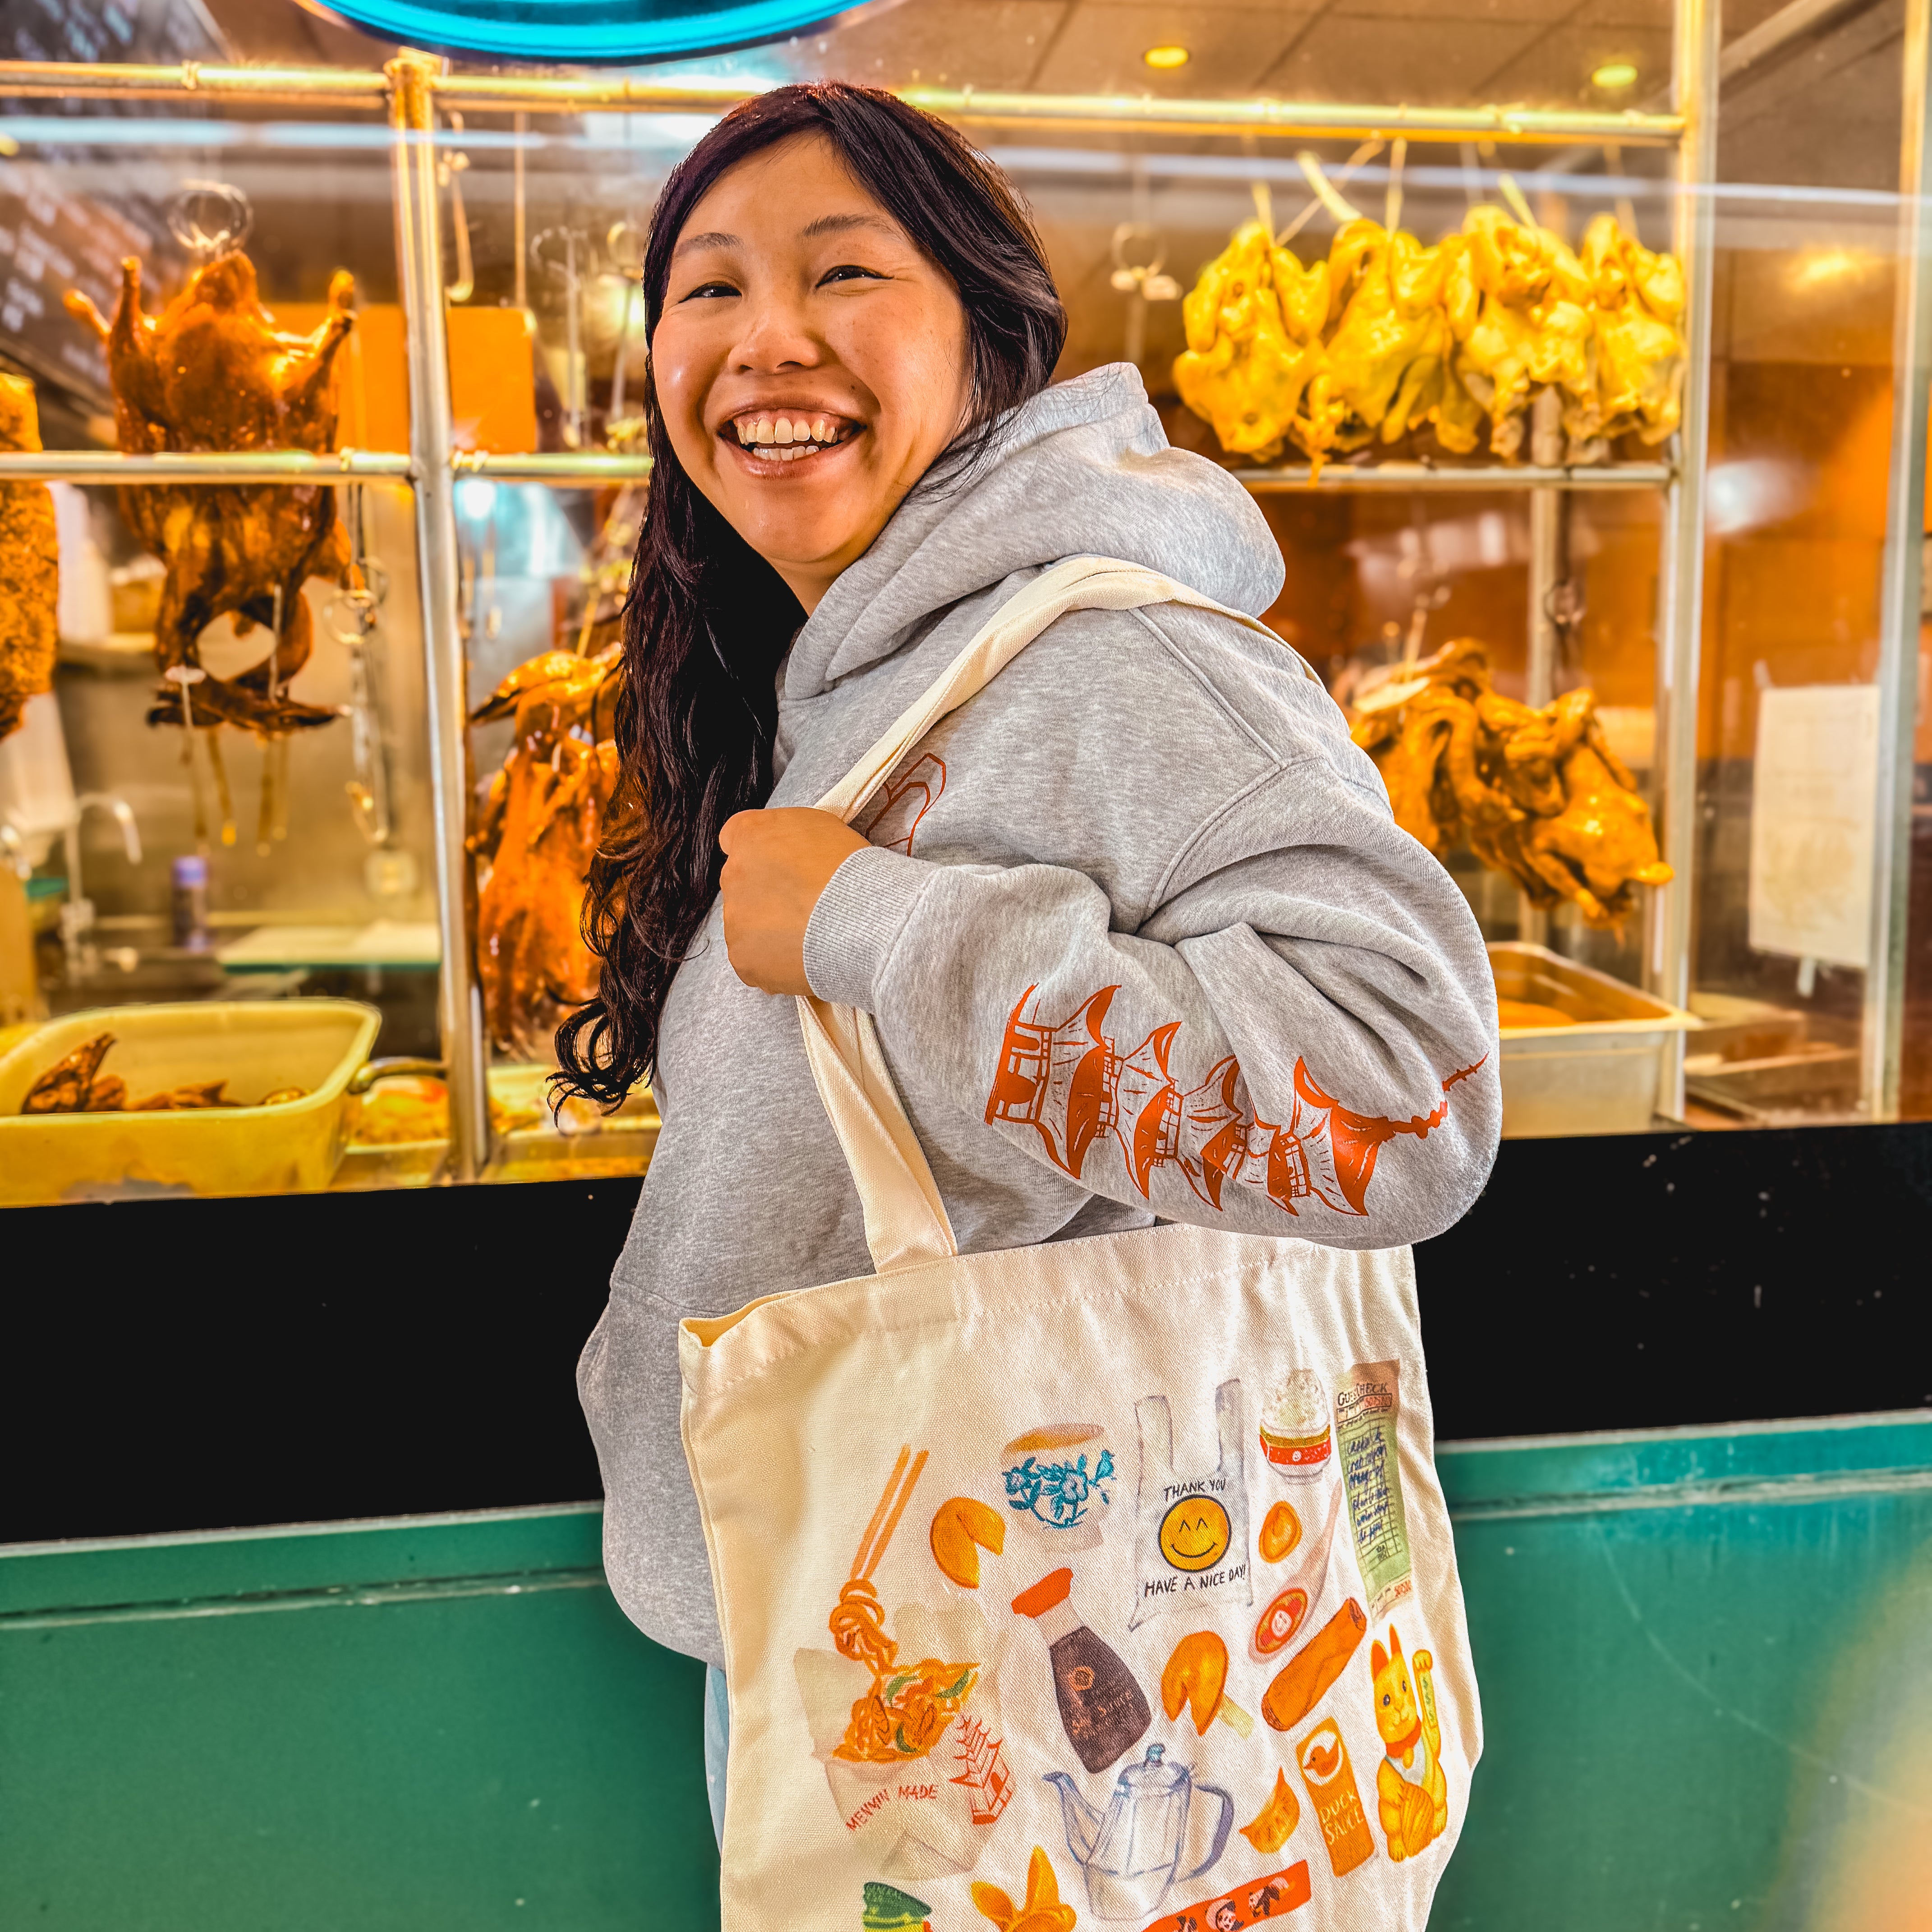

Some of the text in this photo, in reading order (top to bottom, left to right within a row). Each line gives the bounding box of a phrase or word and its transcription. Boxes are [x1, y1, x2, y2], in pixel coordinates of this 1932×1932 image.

[1164, 1478, 1226, 1502] THANK YOU
[1145, 1564, 1246, 1597] HAVE A NICE DAY!
[897, 1783, 939, 1800] MADE
[1320, 1789, 1357, 1824] DUCK
